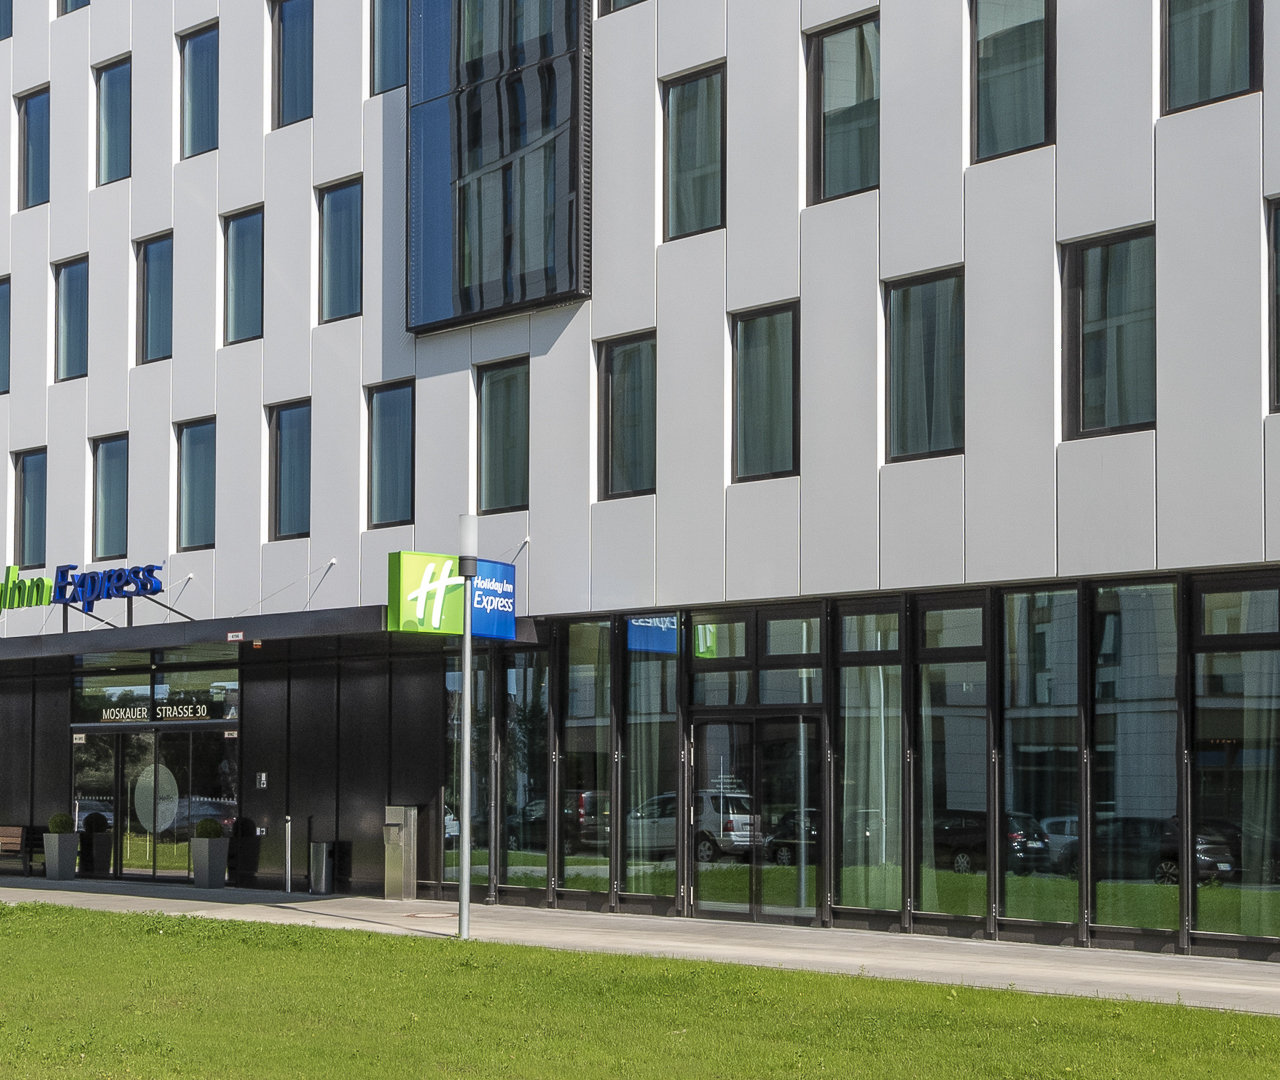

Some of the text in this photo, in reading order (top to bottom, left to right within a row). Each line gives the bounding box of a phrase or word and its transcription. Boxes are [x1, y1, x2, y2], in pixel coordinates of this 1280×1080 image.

[52, 564, 163, 613] Express
[473, 576, 513, 594] Holiday Inn
[473, 592, 514, 613] Express
[102, 705, 207, 720] MOSKAUER STRASSE 30
